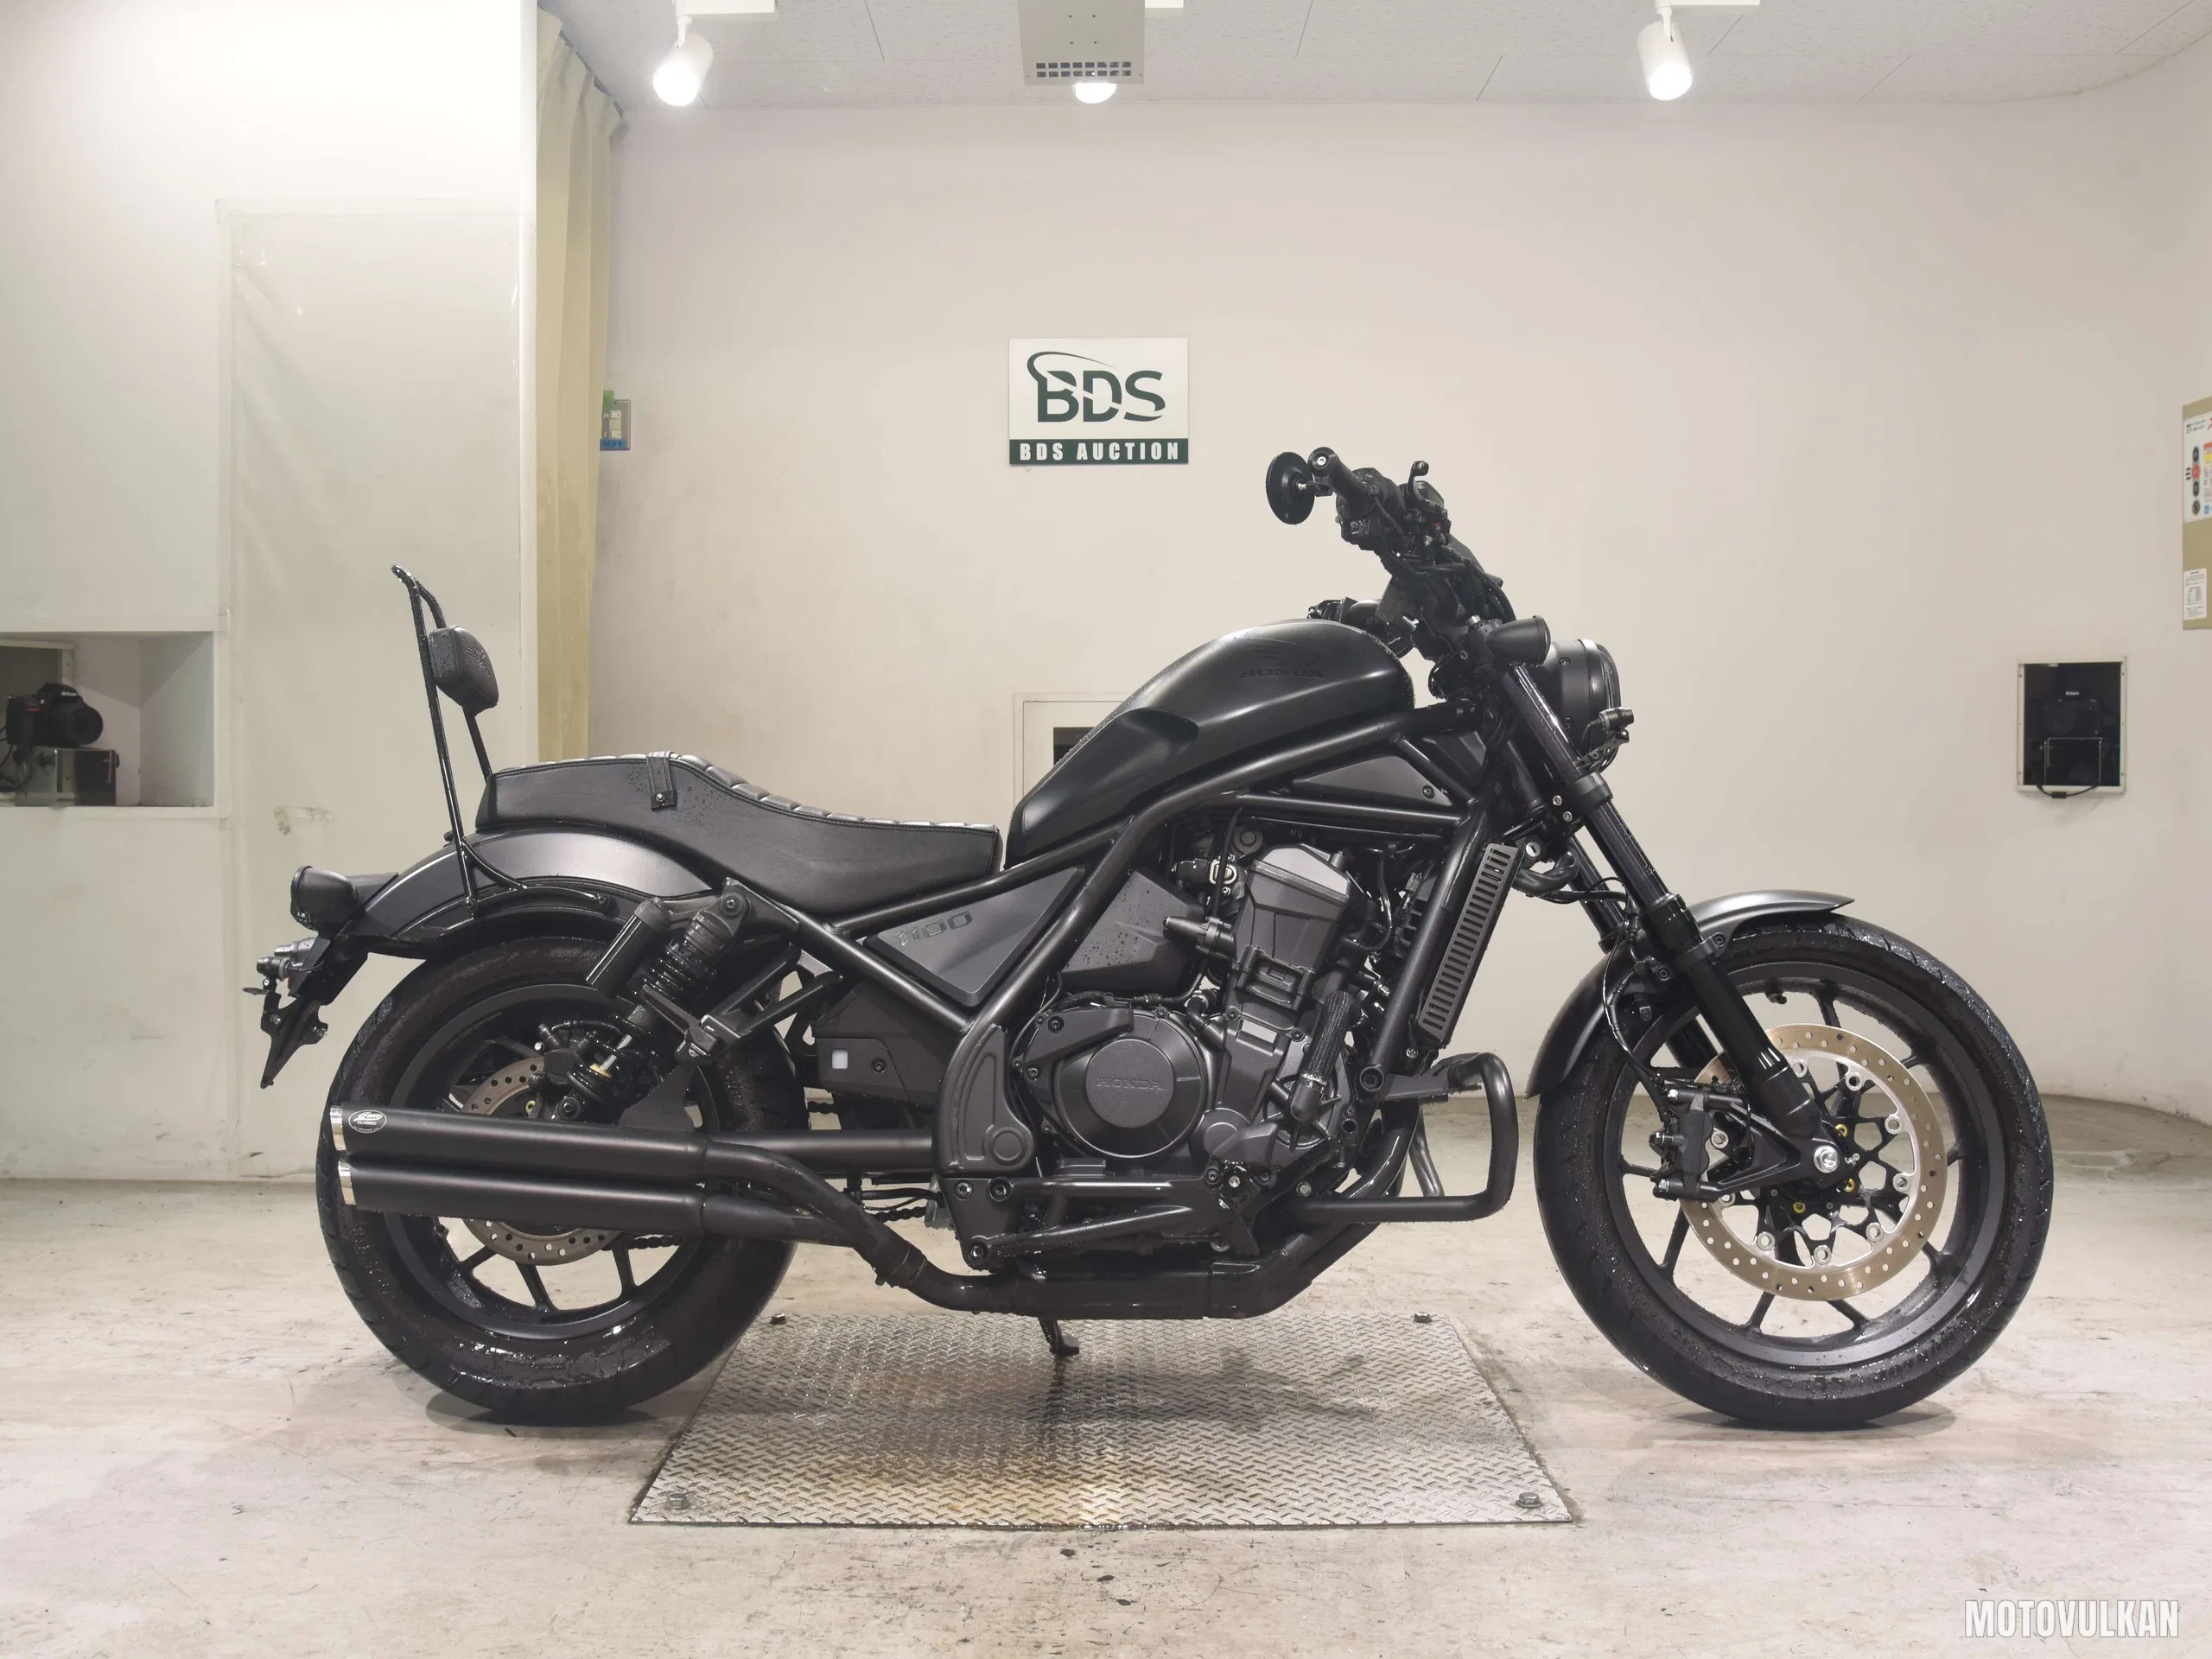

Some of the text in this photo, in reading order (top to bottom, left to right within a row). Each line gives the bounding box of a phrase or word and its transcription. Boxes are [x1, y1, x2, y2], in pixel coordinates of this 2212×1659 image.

[1027, 351, 1166, 423] BDS
[1020, 442, 1179, 461] BDS AUCTION
[1239, 668, 1325, 680] HONDA
[893, 911, 973, 946] 1100
[1096, 1077, 1164, 1090] HONDA
